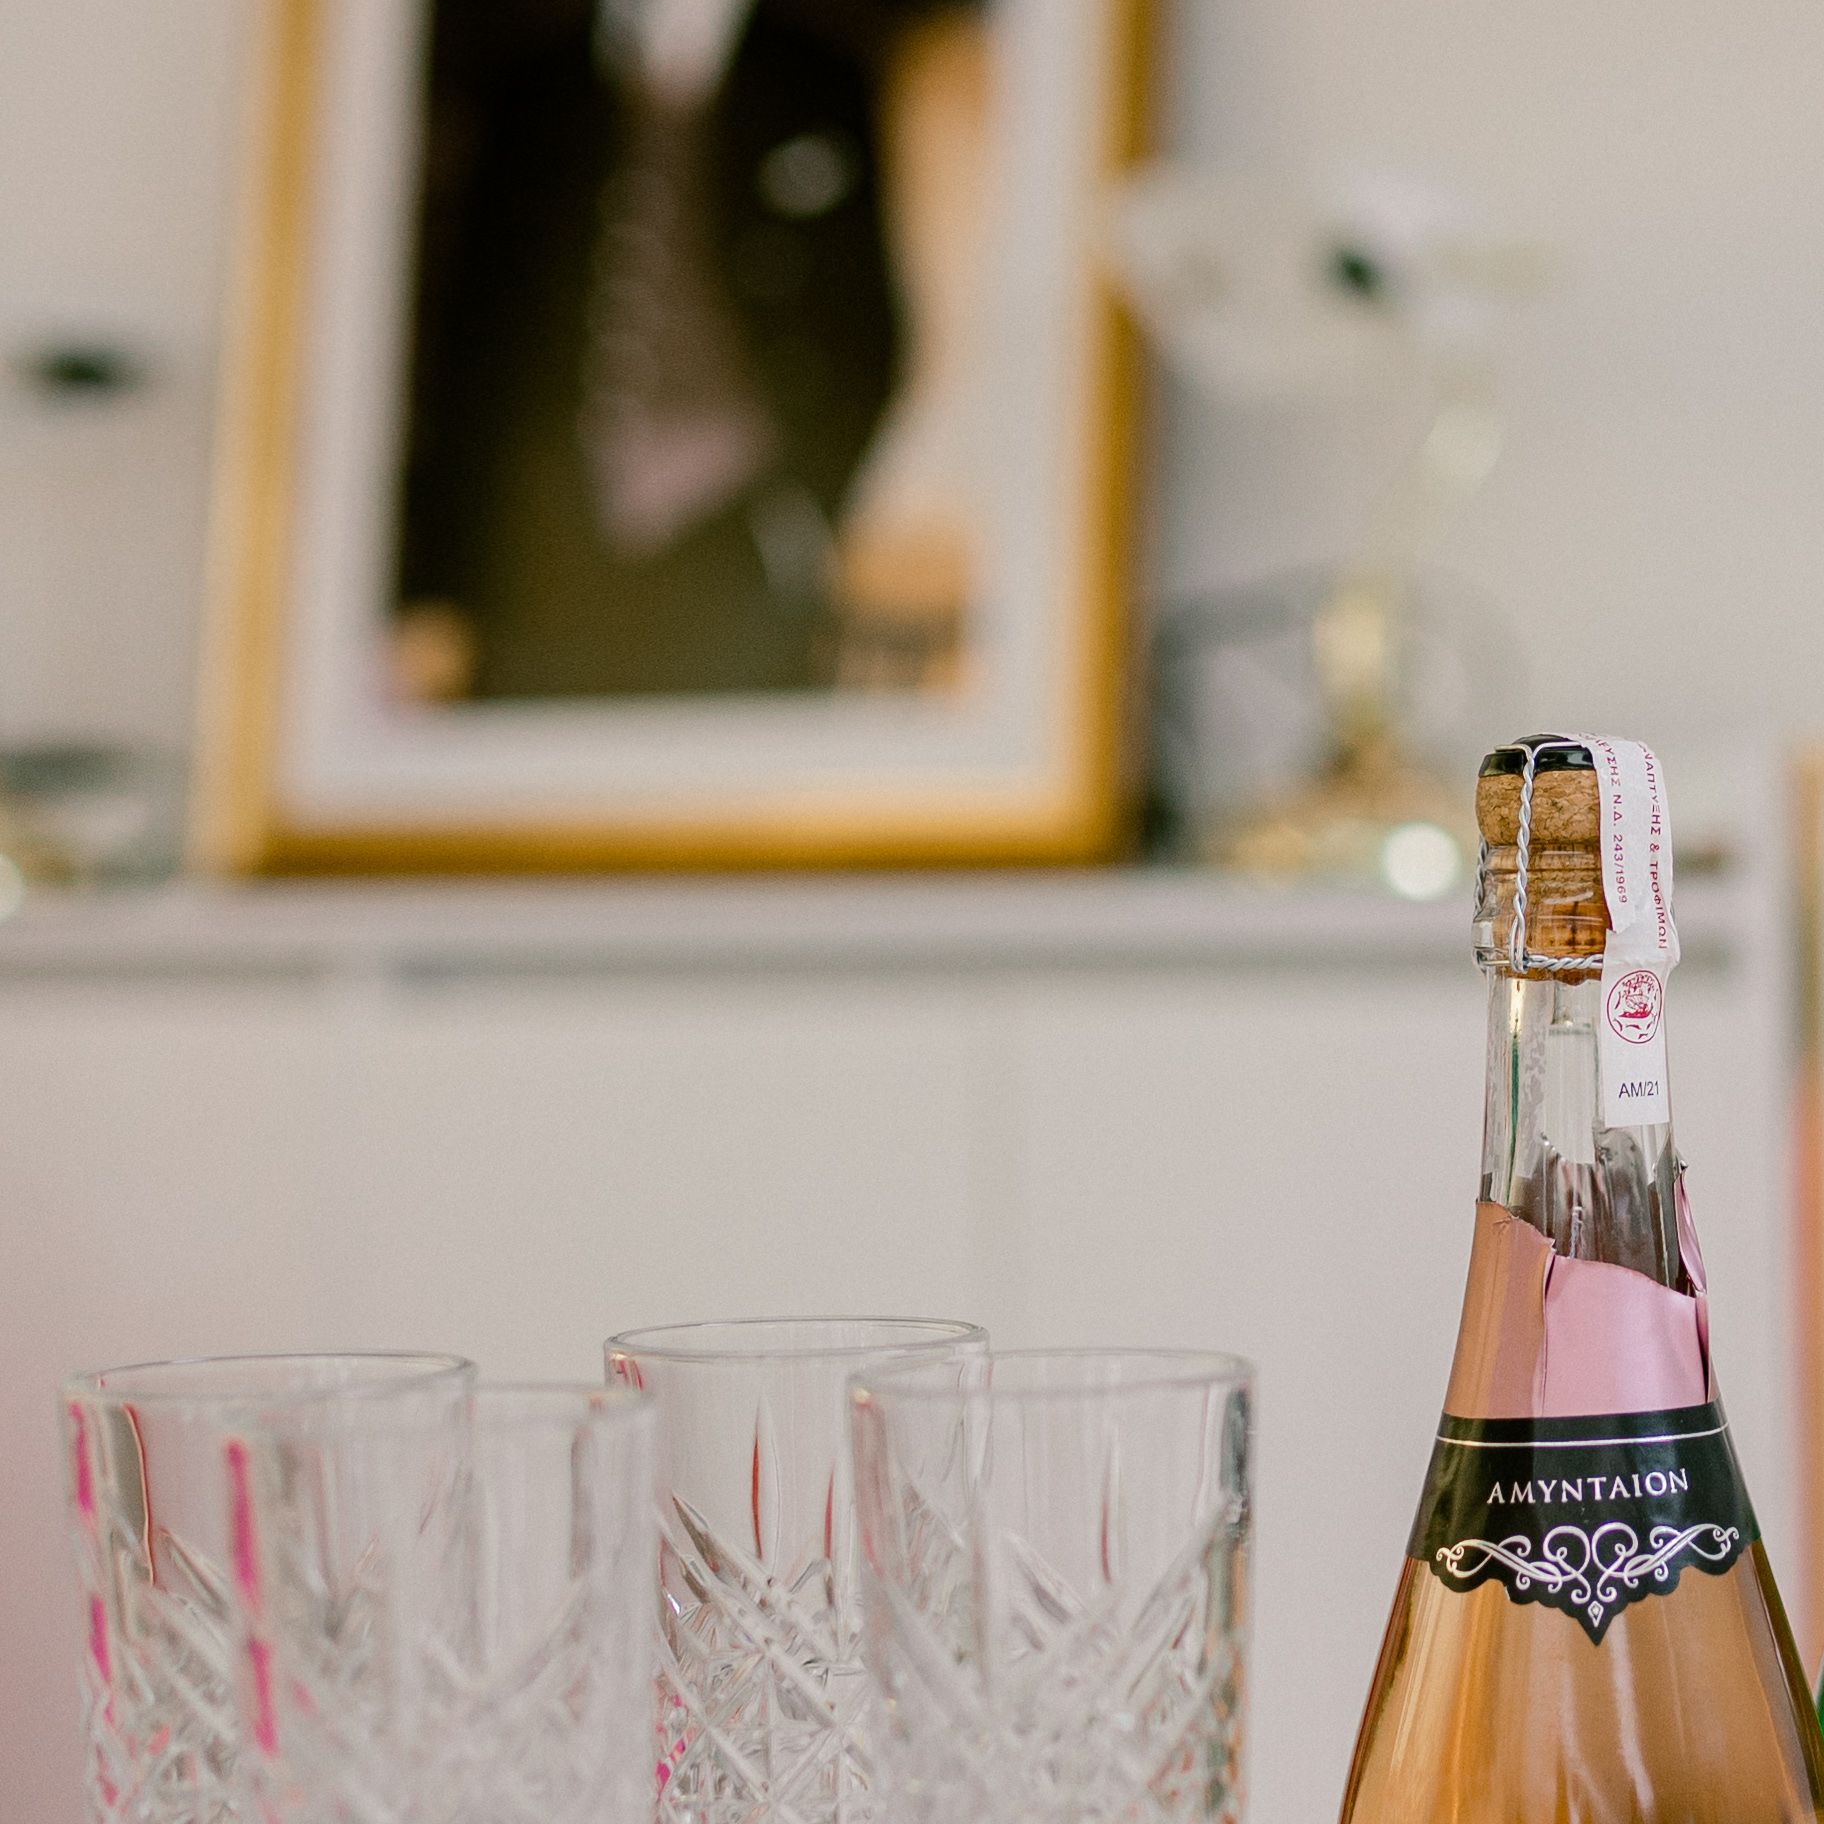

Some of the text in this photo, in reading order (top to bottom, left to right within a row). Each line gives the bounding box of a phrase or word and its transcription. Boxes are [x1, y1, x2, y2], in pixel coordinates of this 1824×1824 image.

[1650, 843, 1660, 852] &
[1612, 834, 1628, 904] 243/1969
[1649, 862, 1668, 950] ΤΡΟΦΙΜΩΝ
[1618, 1080, 1660, 1099] AM/21
[1486, 1467, 1689, 1505] AMYNTAION
